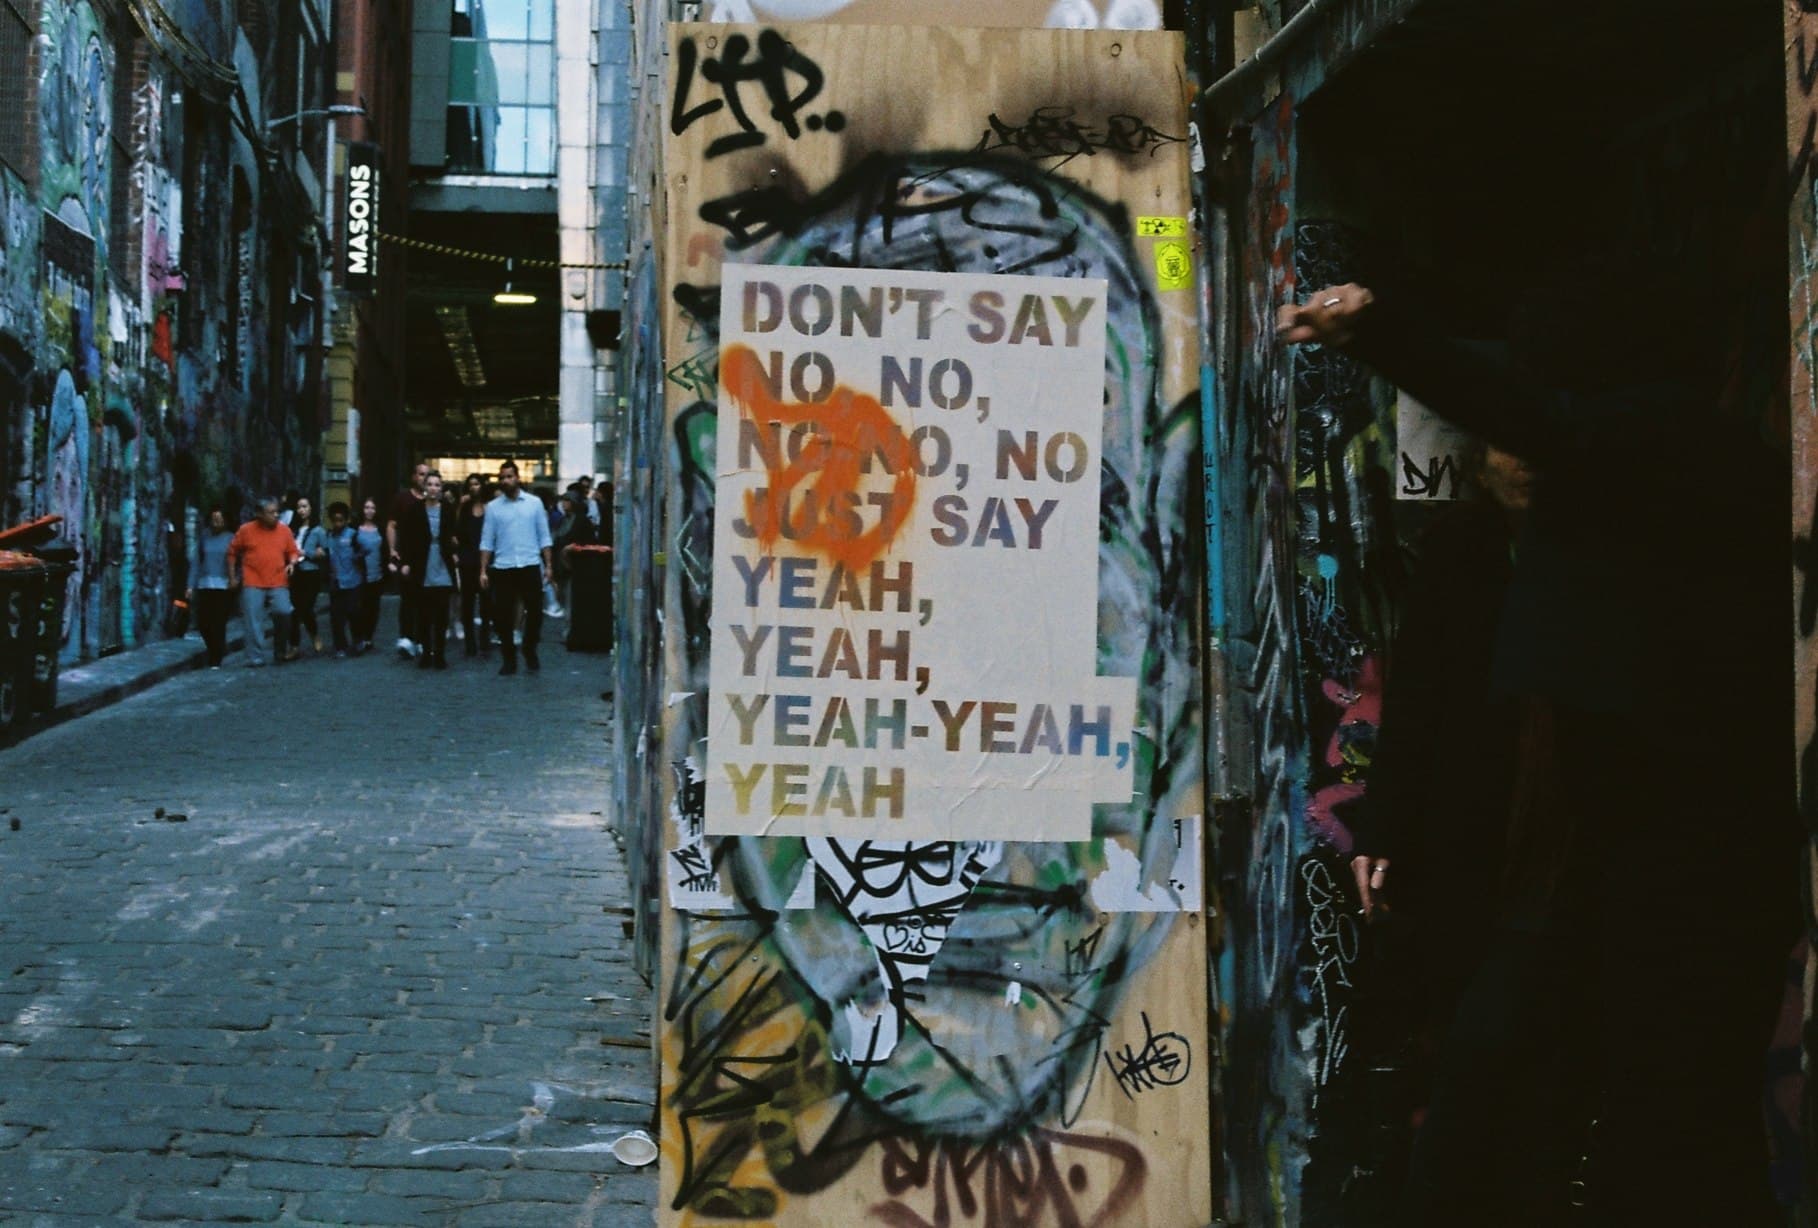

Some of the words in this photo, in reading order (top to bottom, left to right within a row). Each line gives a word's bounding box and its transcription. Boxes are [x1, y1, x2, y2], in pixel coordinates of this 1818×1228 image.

[347, 164, 371, 274] MASONS
[741, 281, 945, 340] DON'T
[967, 290, 1096, 347] SAY
[740, 350, 836, 404] NO
[880, 355, 991, 423] NO,
[859, 423, 970, 491] NO,
[995, 429, 1089, 484] NO
[732, 487, 907, 543] JUST
[930, 494, 1060, 550] SAY
[731, 555, 933, 627] YEAH,
[729, 624, 931, 696] YEAH,
[725, 693, 1130, 770] YEAH-YEAH,
[723, 762, 906, 820] YEAH
